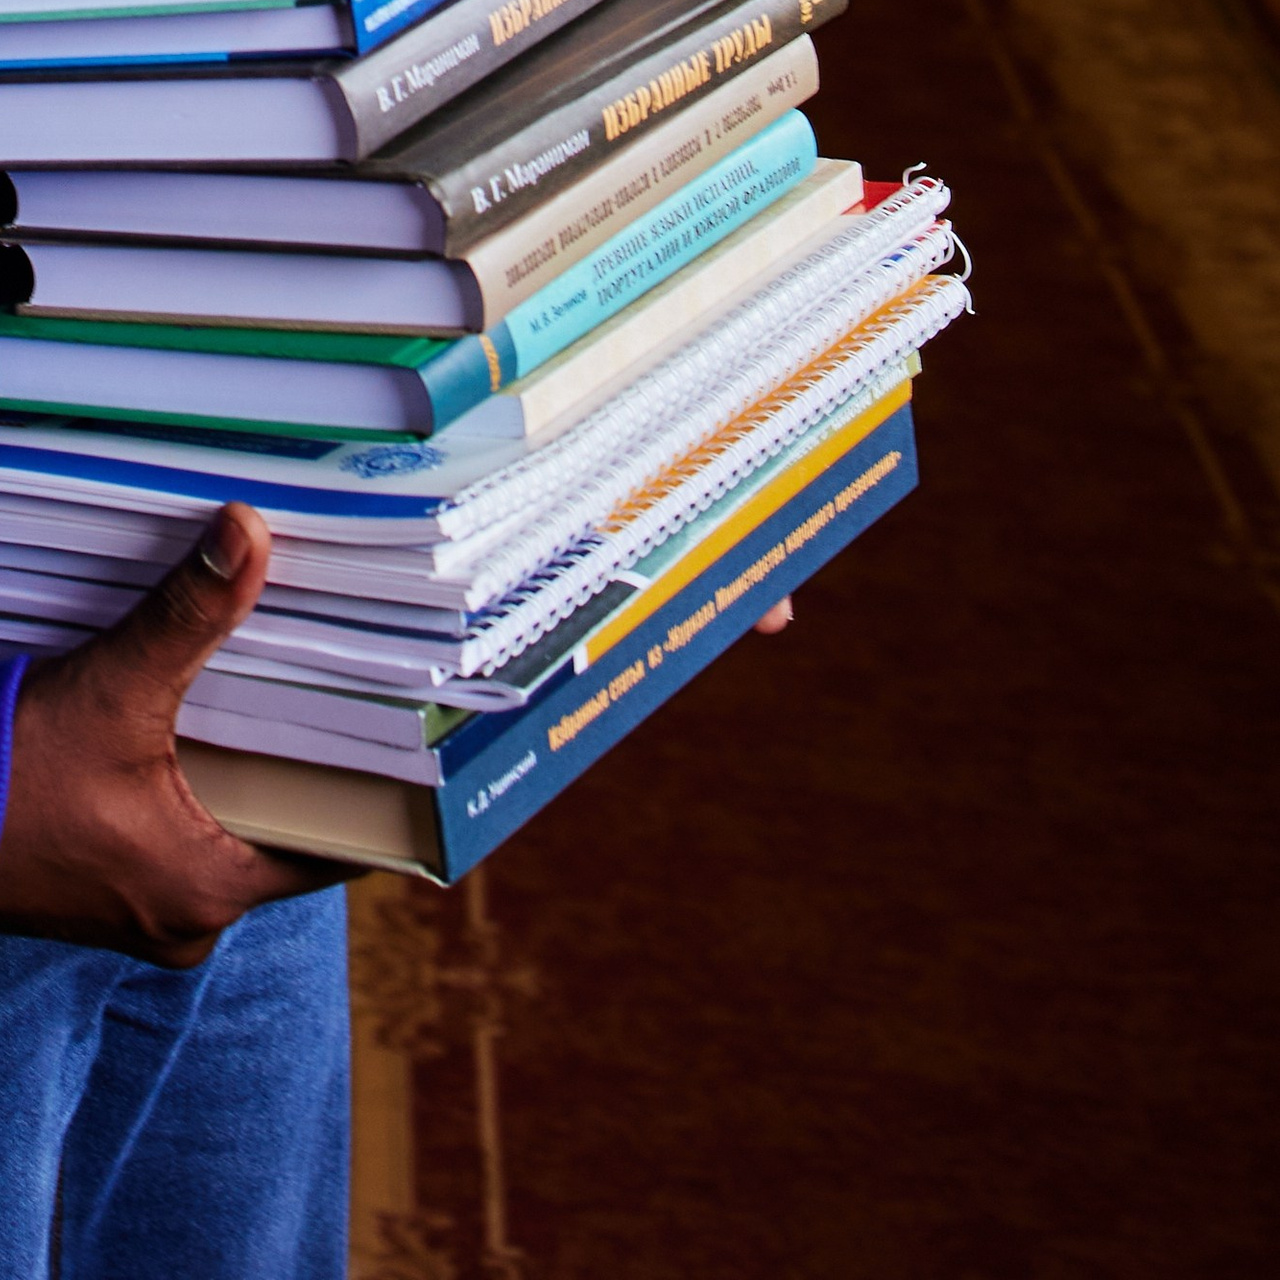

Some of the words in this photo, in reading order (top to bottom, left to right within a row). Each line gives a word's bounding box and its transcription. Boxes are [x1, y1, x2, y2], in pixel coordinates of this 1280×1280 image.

[471, 187, 491, 213] В.
[489, 176, 506, 202] Г.
[600, 49, 710, 140] ИЗБРАННЫЕ
[710, 14, 772, 73] ТРУДЫ
[592, 232, 647, 279] ДРЕВНИЕ
[649, 201, 693, 239] ЯЗЫКИ
[692, 160, 759, 211] ИСПАНИИ,
[597, 238, 680, 305] ПОРТУГАЛИИ
[680, 229, 692, 248] И
[692, 196, 740, 239] ЮЖНОЙ
[742, 157, 800, 205] ФРАНЦИИ
[548, 689, 609, 749] Избранные
[608, 660, 644, 700] статьи
[647, 644, 663, 668] из
[784, 502, 835, 553] народного
